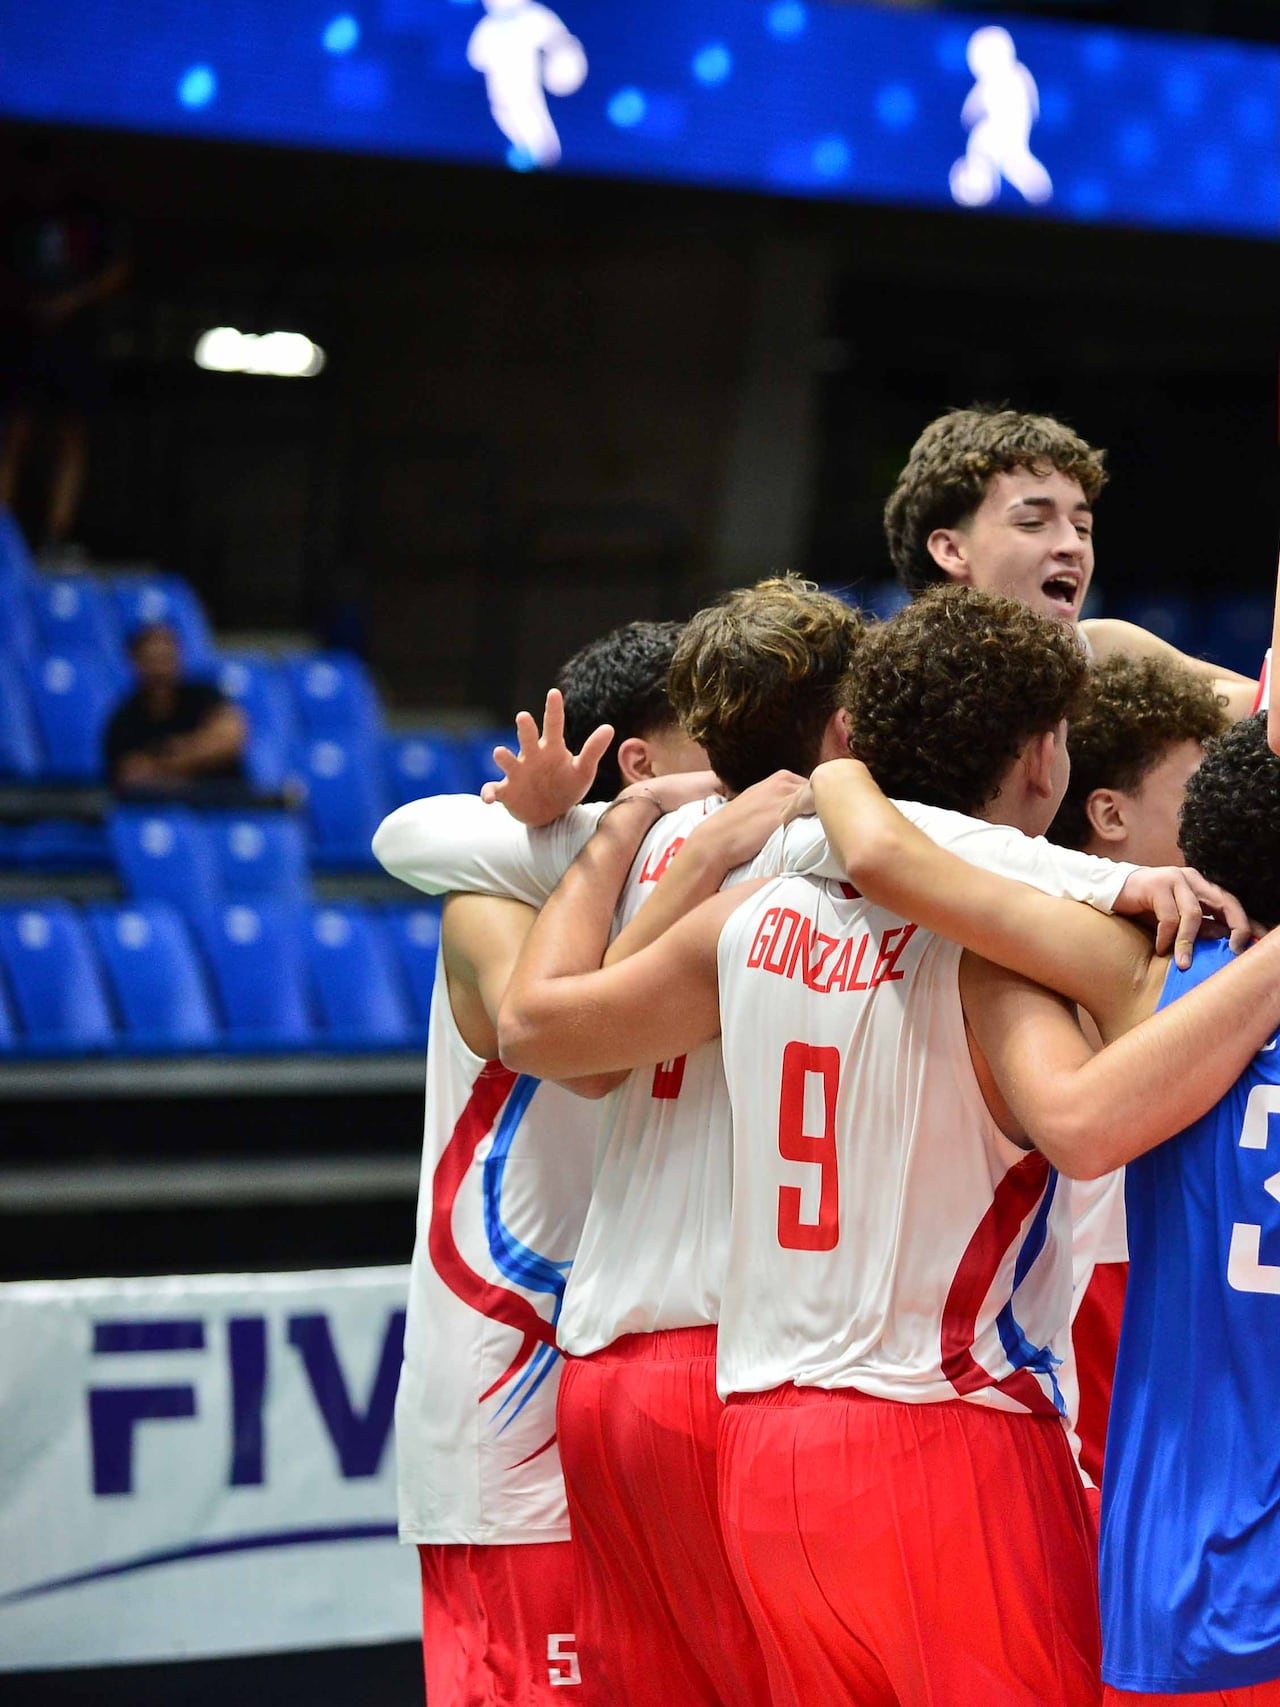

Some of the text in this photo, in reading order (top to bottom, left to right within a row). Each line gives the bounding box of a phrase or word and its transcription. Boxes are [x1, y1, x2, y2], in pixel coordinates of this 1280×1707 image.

[747, 906, 918, 993] GONZALEZ
[777, 1040, 841, 1252] 9
[547, 1633, 582, 1686] 5
